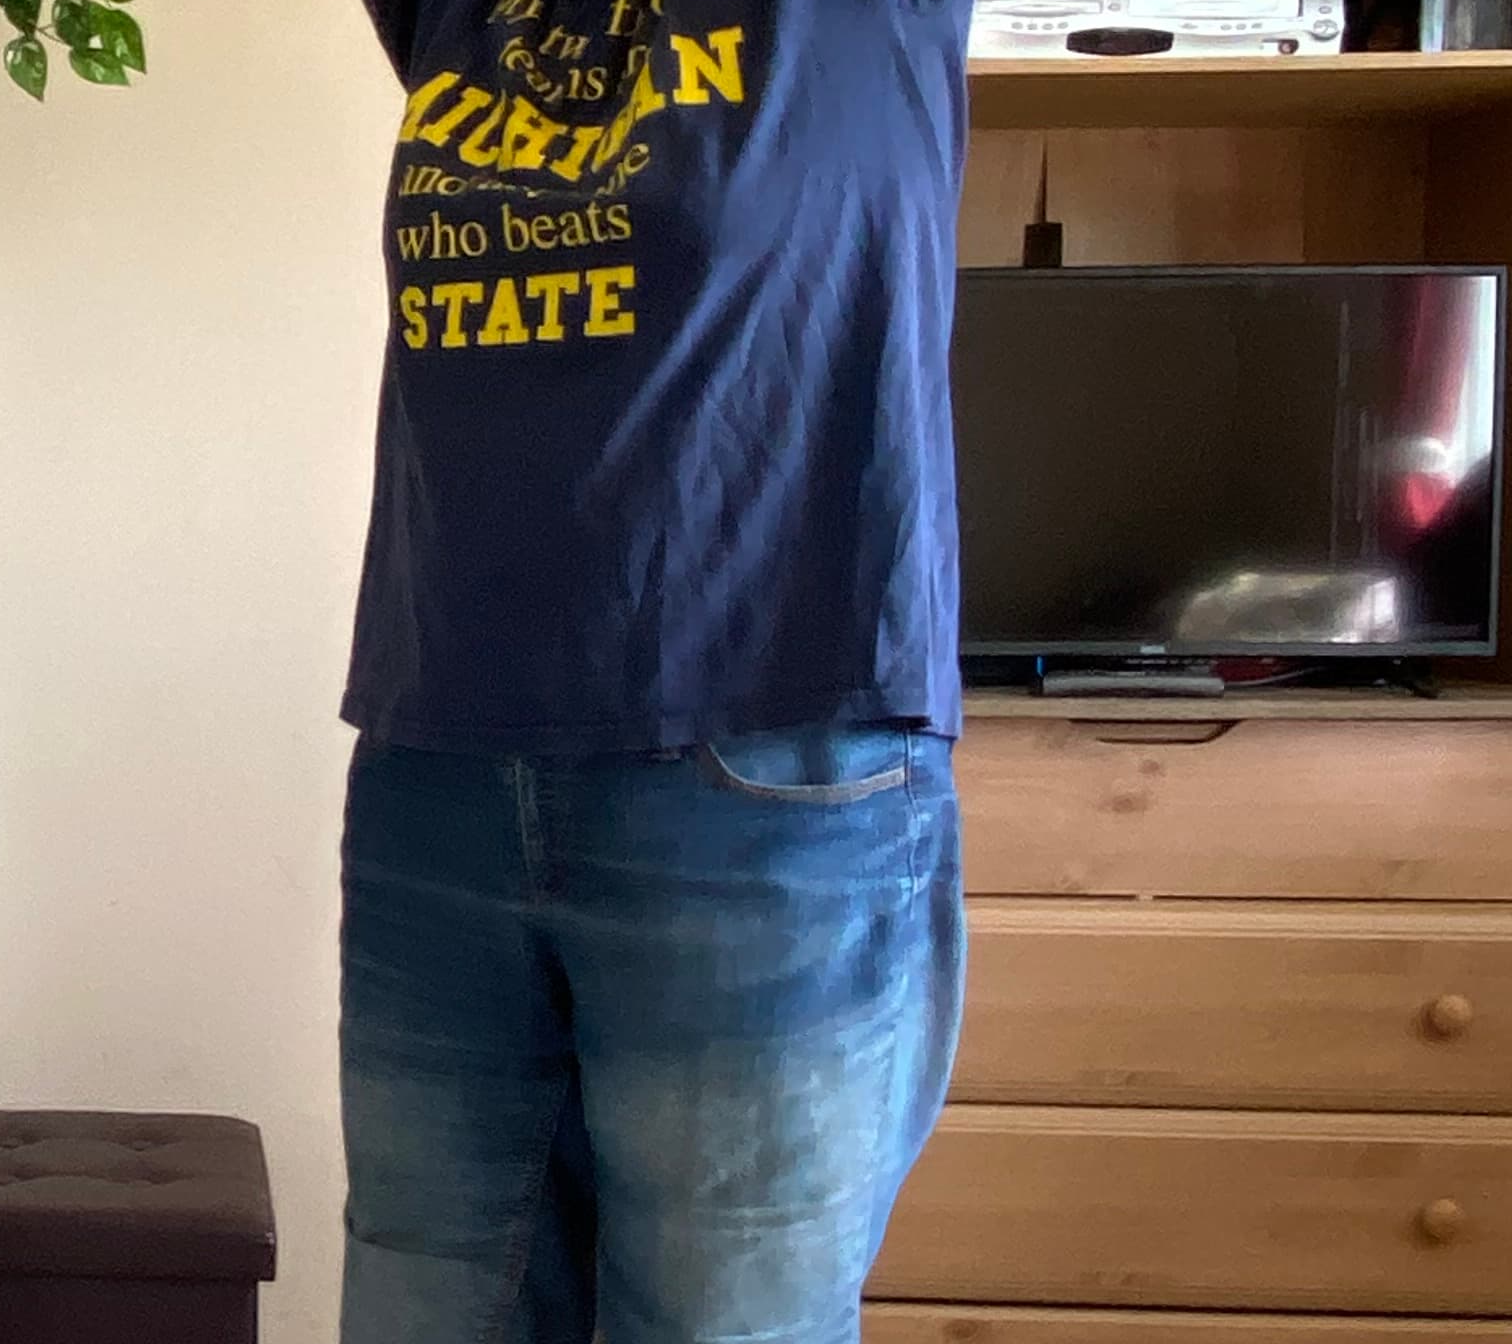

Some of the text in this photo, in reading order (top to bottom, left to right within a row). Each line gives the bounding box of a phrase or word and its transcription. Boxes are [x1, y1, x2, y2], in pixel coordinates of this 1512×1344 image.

[398, 25, 744, 182] ICHIAN
[397, 202, 632, 262] who beats
[399, 265, 636, 351] STATE
